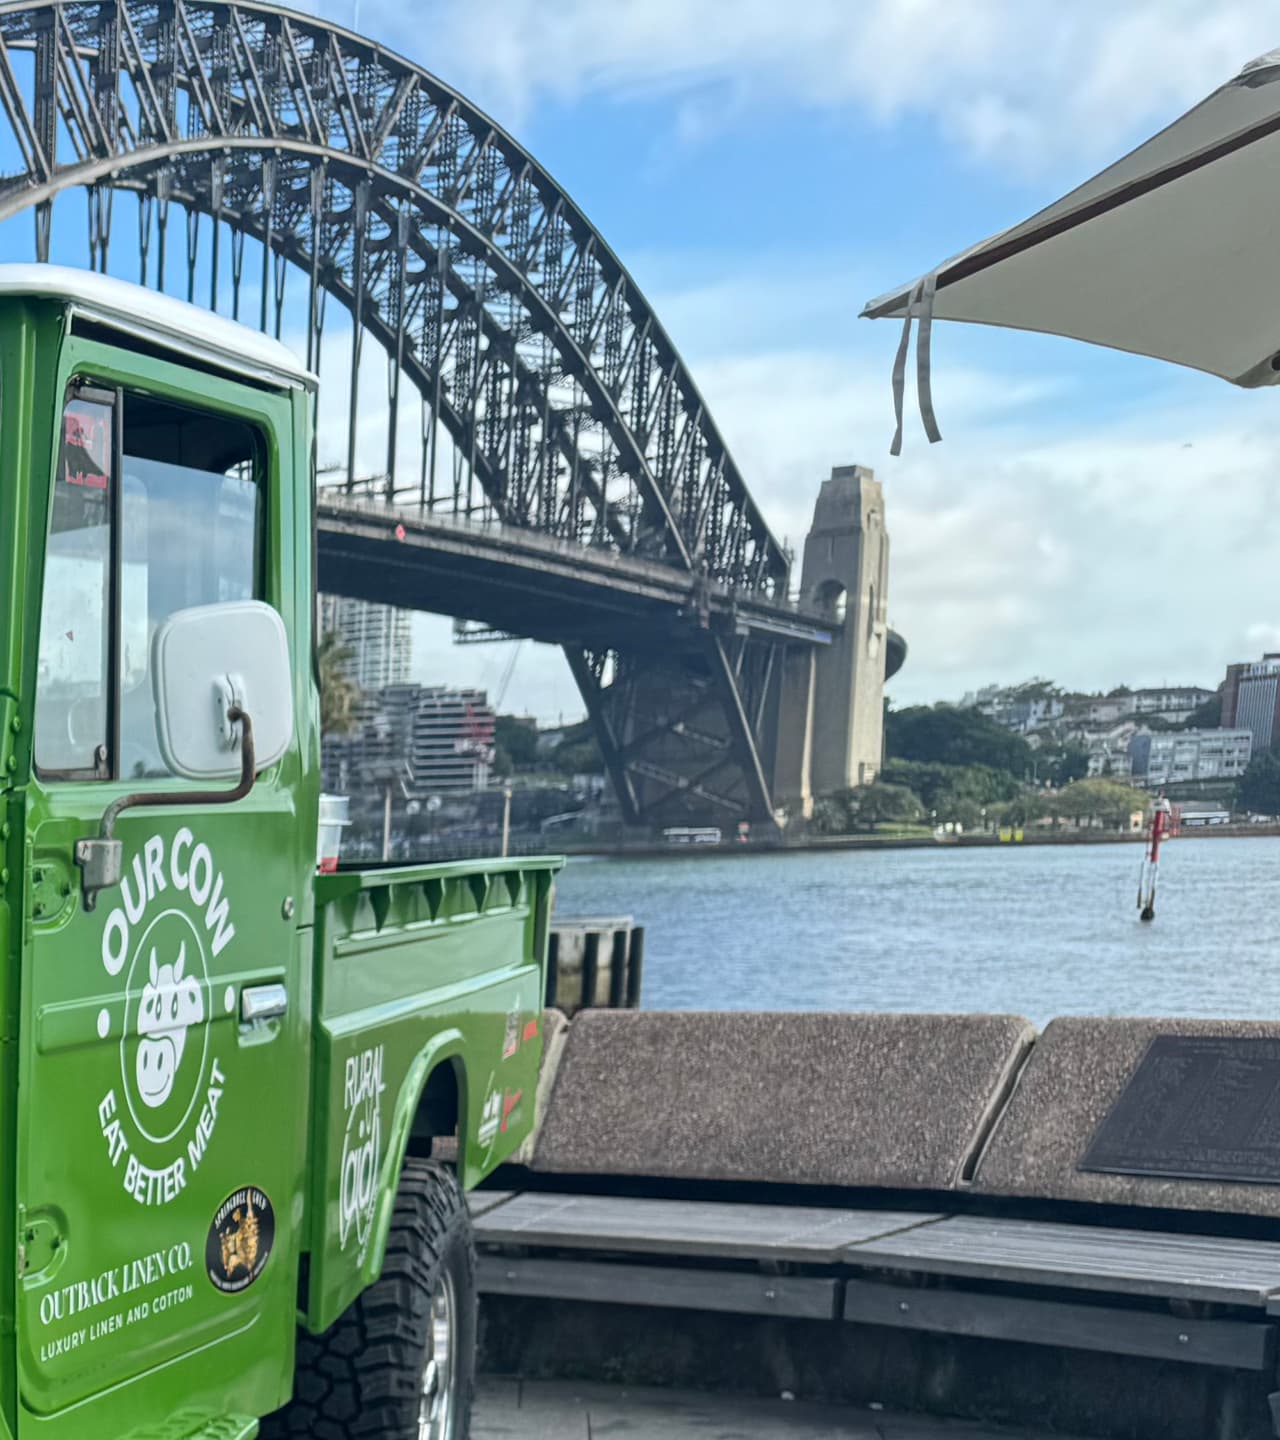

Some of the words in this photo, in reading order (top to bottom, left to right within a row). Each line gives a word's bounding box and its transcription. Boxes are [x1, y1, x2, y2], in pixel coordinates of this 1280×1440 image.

[101, 834, 167, 976] OUR
[170, 827, 235, 958] COW
[98, 1088, 128, 1167] EAT
[123, 1153, 186, 1206] BETTER
[187, 1057, 225, 1171] MEAT
[40, 1267, 120, 1325] OUTBACK
[122, 1250, 167, 1293] LINEN
[168, 1241, 193, 1275] CO.
[40, 1329, 86, 1362] LUXURY
[90, 1313, 123, 1341] LINEN
[126, 1302, 150, 1325] AND
[152, 1285, 193, 1314] COTTON
